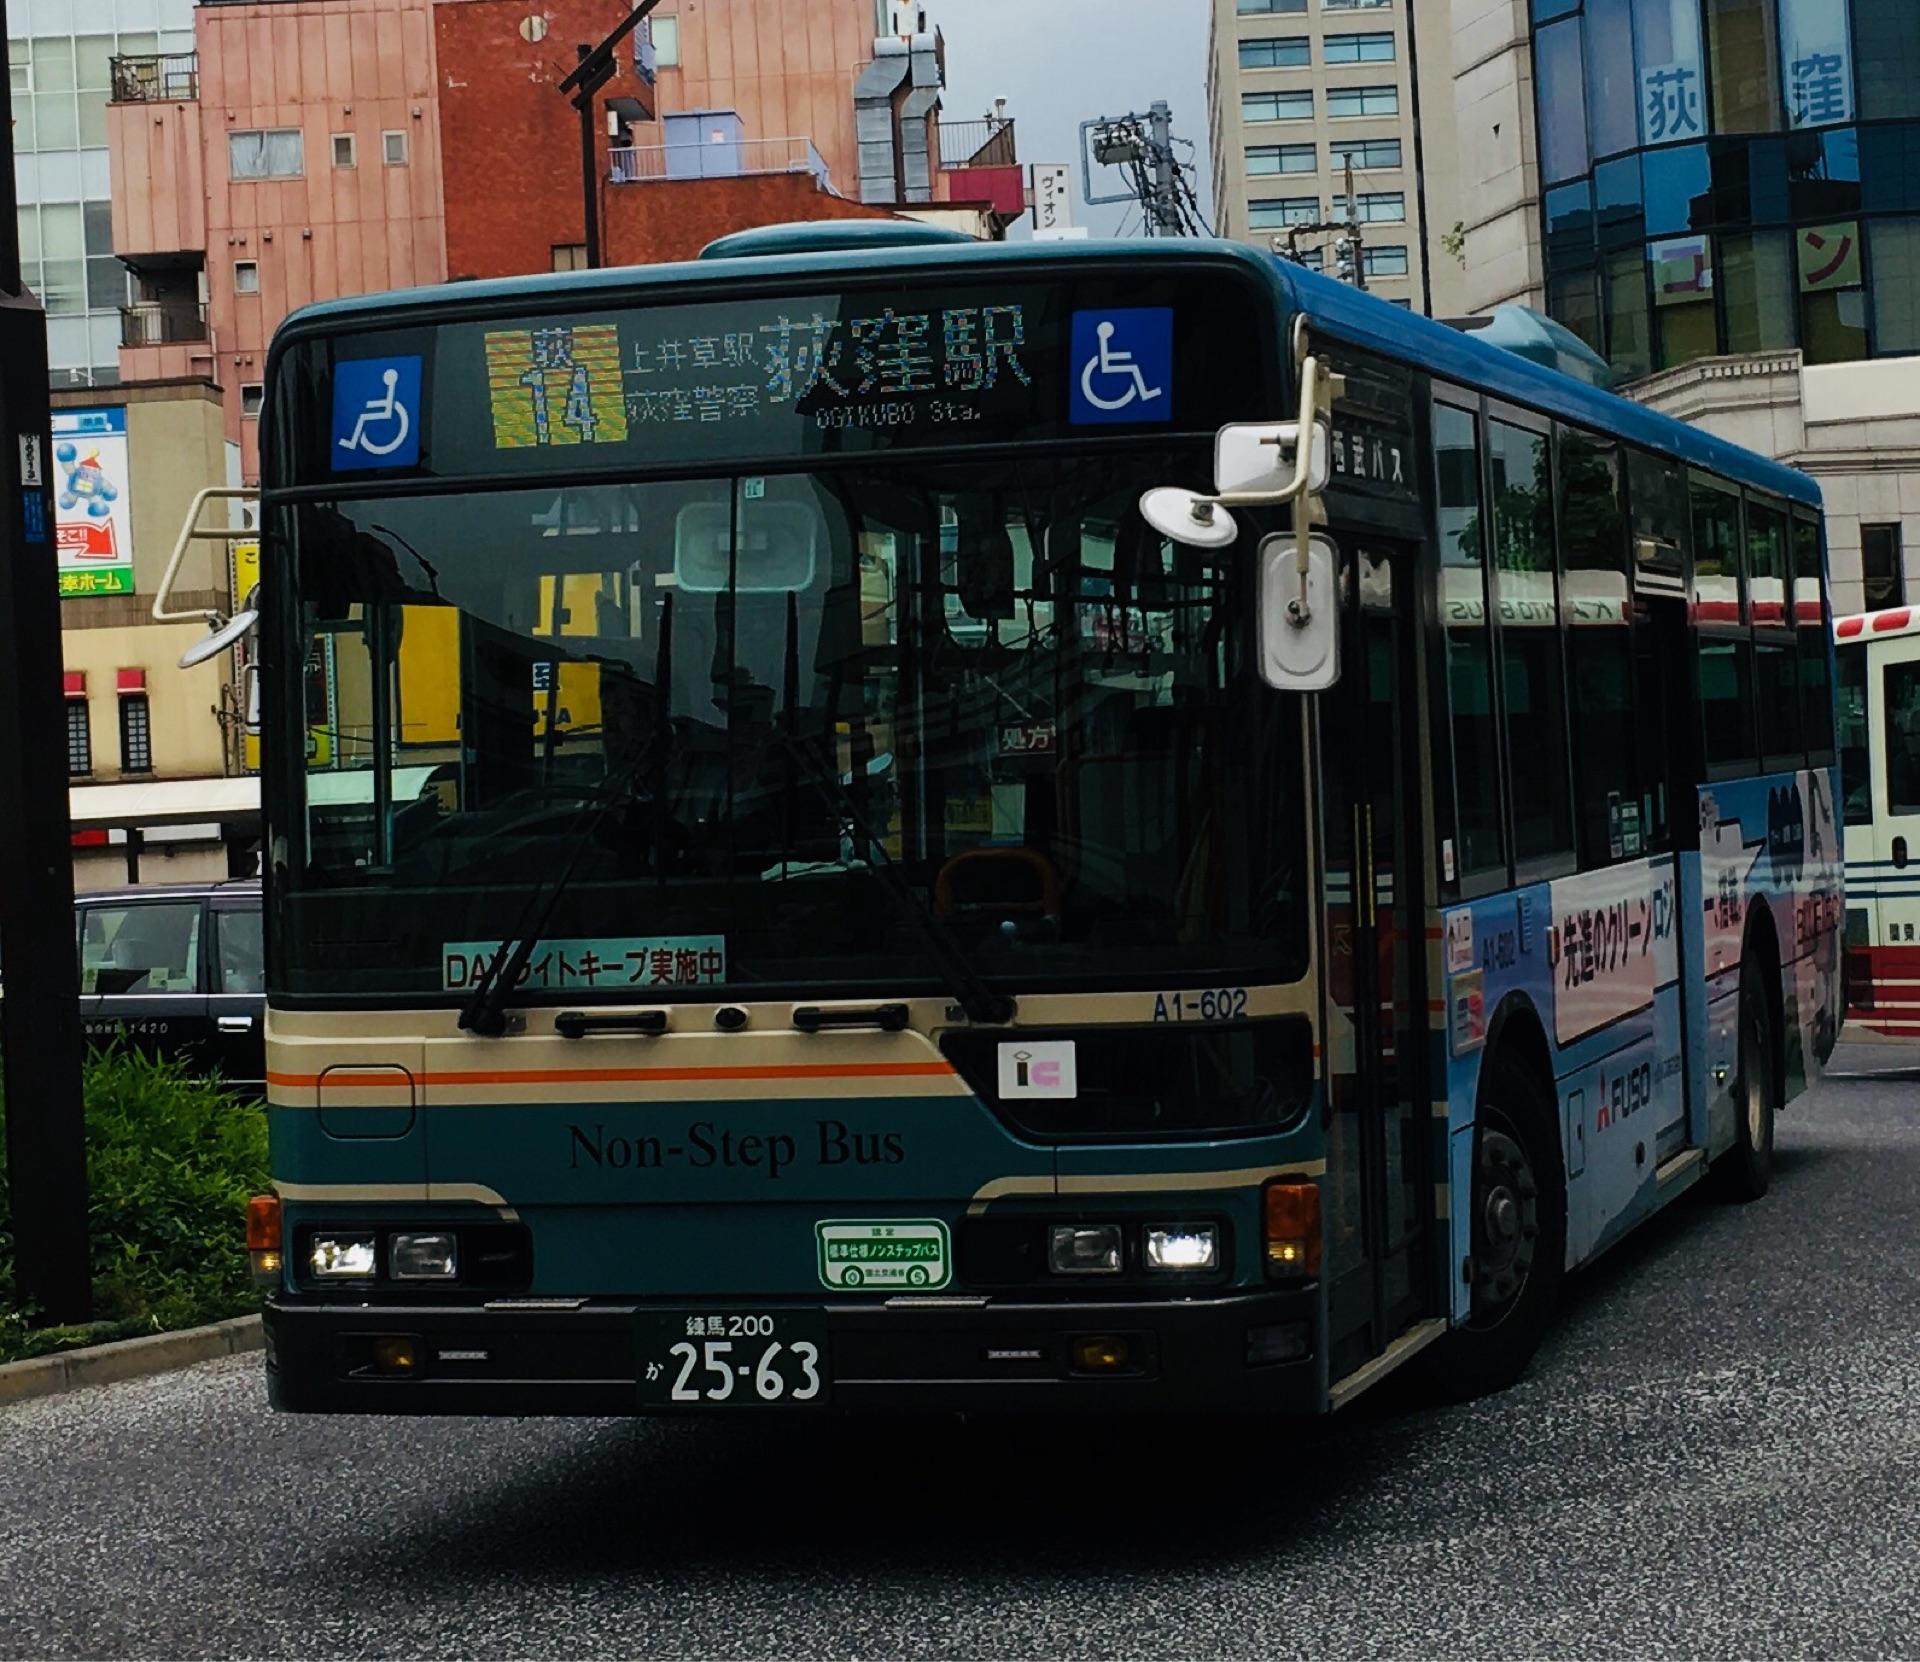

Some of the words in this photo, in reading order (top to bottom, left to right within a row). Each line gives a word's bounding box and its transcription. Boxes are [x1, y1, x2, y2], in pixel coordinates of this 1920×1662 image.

[1646, 67, 1699, 140] 荻
[1791, 53, 1845, 125] 窪
[624, 332, 760, 375] 上井草駅
[759, 304, 1032, 403] 荻窪駅
[519, 366, 598, 444] 14
[625, 384, 761, 424] 荻窪警察
[815, 401, 916, 430] OGIKUBO
[59, 574, 122, 592] 幸ホーム
[1002, 724, 1057, 751] 処方
[1153, 988, 1249, 1023] A1-602
[567, 1120, 796, 1179] Non-Step
[815, 1119, 906, 1166] Bus
[645, 1361, 665, 1381] か
[668, 1341, 821, 1401] 25-63
